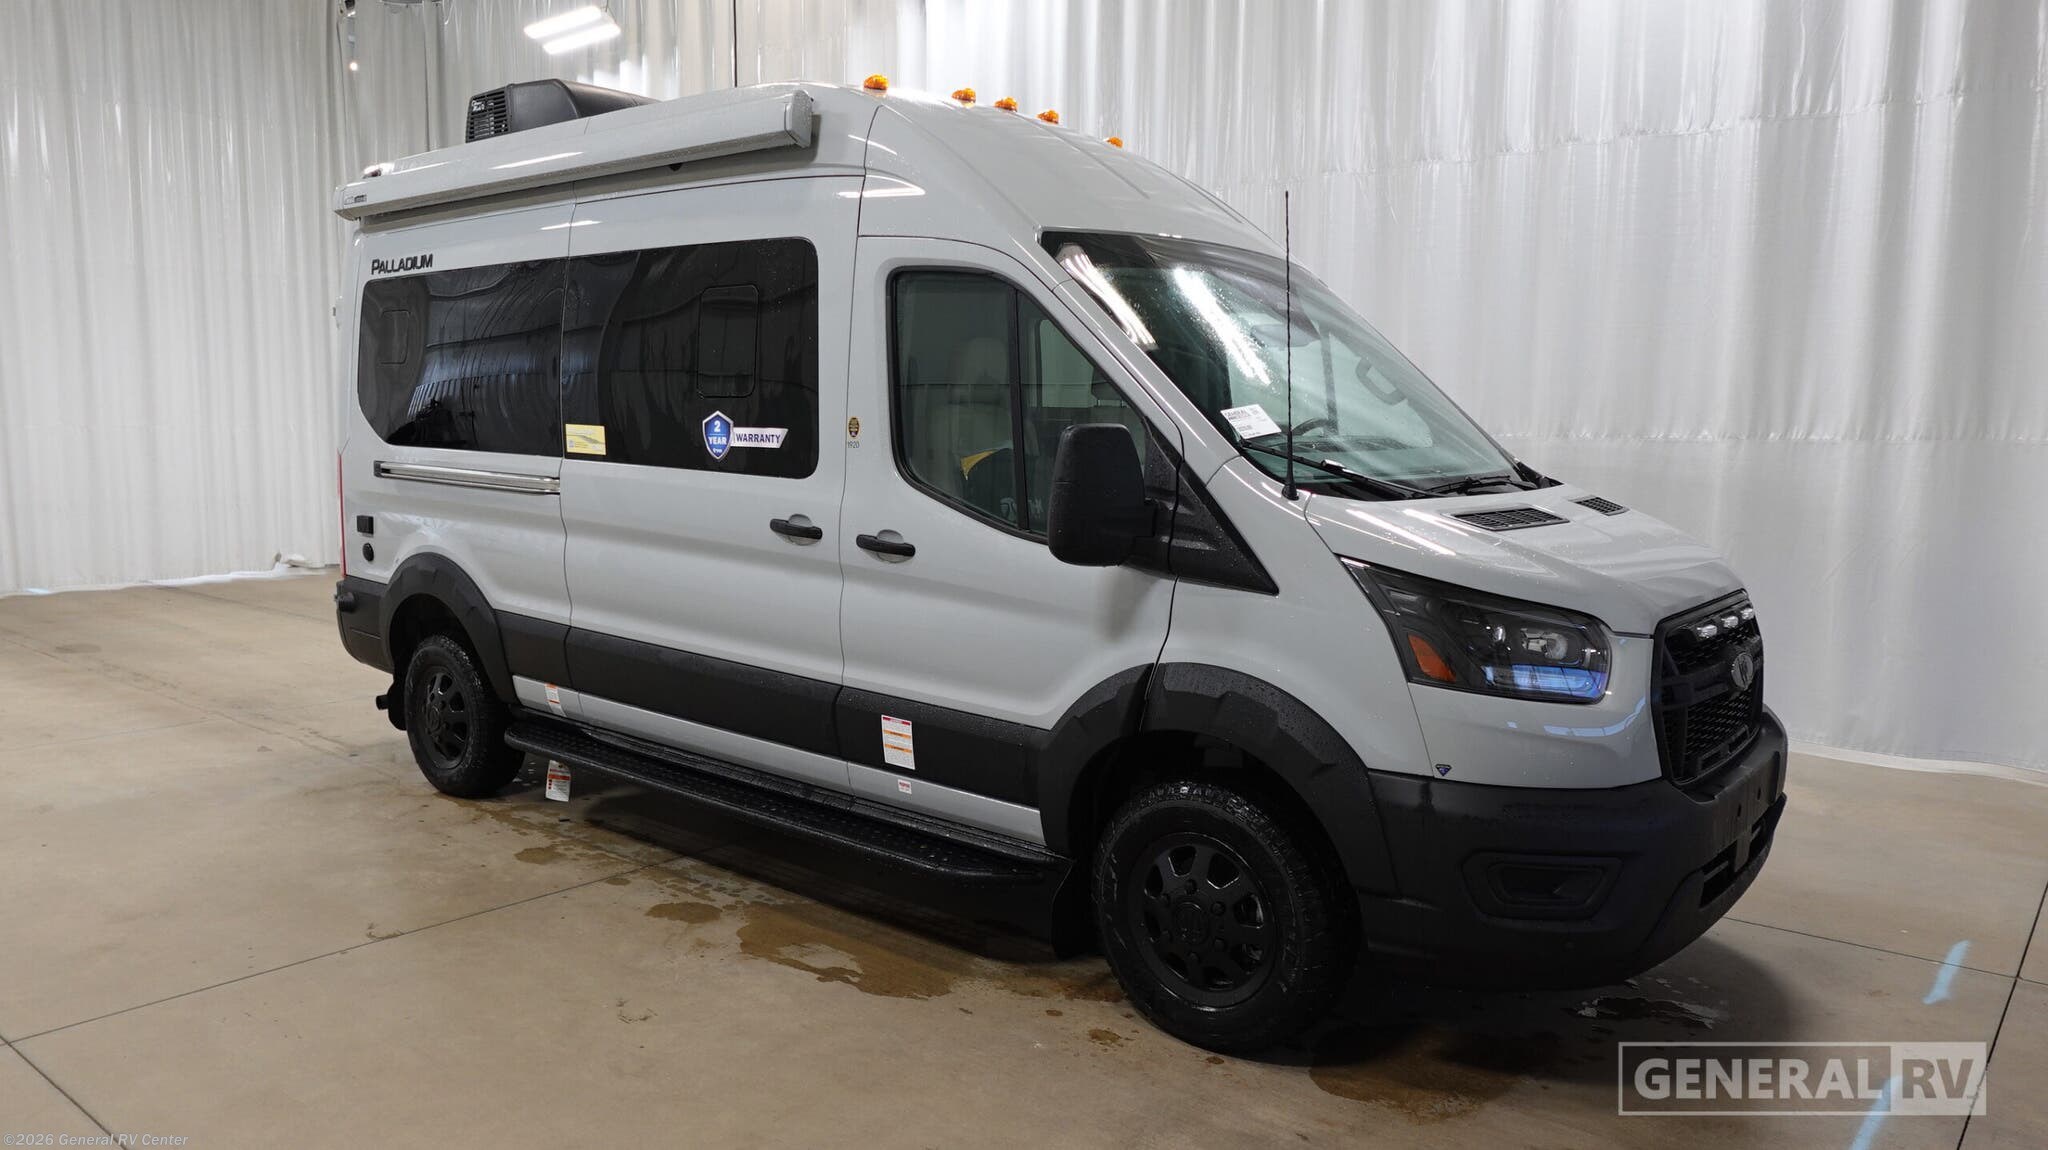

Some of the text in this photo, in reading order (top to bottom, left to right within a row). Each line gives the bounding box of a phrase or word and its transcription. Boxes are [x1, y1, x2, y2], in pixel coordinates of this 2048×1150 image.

[371, 253, 433, 276] PALLADIUM
[713, 420, 721, 432] 2
[708, 436, 727, 445] YEAR
[736, 433, 781, 445] WARRANTY
